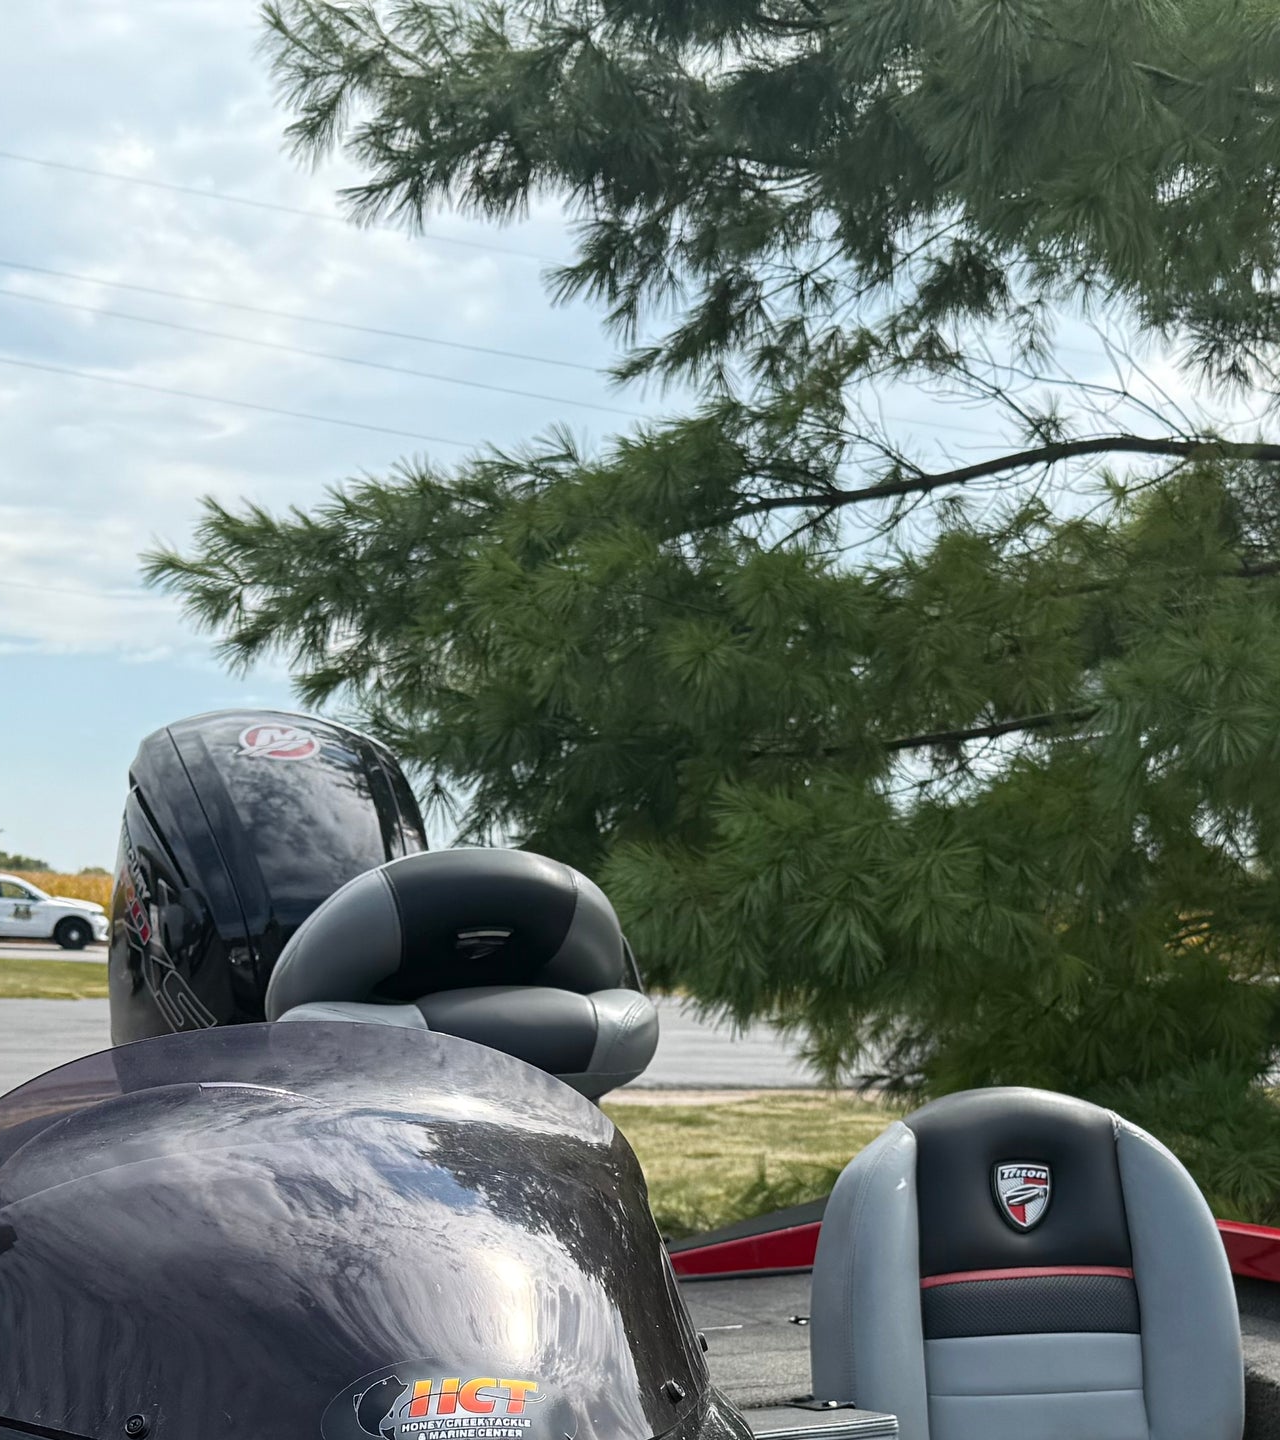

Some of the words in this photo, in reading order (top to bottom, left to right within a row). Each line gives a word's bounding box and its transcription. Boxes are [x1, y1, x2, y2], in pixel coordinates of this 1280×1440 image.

[1001, 1167, 1047, 1179] Triton
[408, 1377, 539, 1418] HCT
[401, 1420, 442, 1433] HONEY
[446, 1418, 485, 1429] CREEK
[486, 1418, 531, 1428] TACKLE
[418, 1432, 426, 1440] &
[429, 1429, 476, 1440] MARINE
[478, 1428, 523, 1438] CENTER
